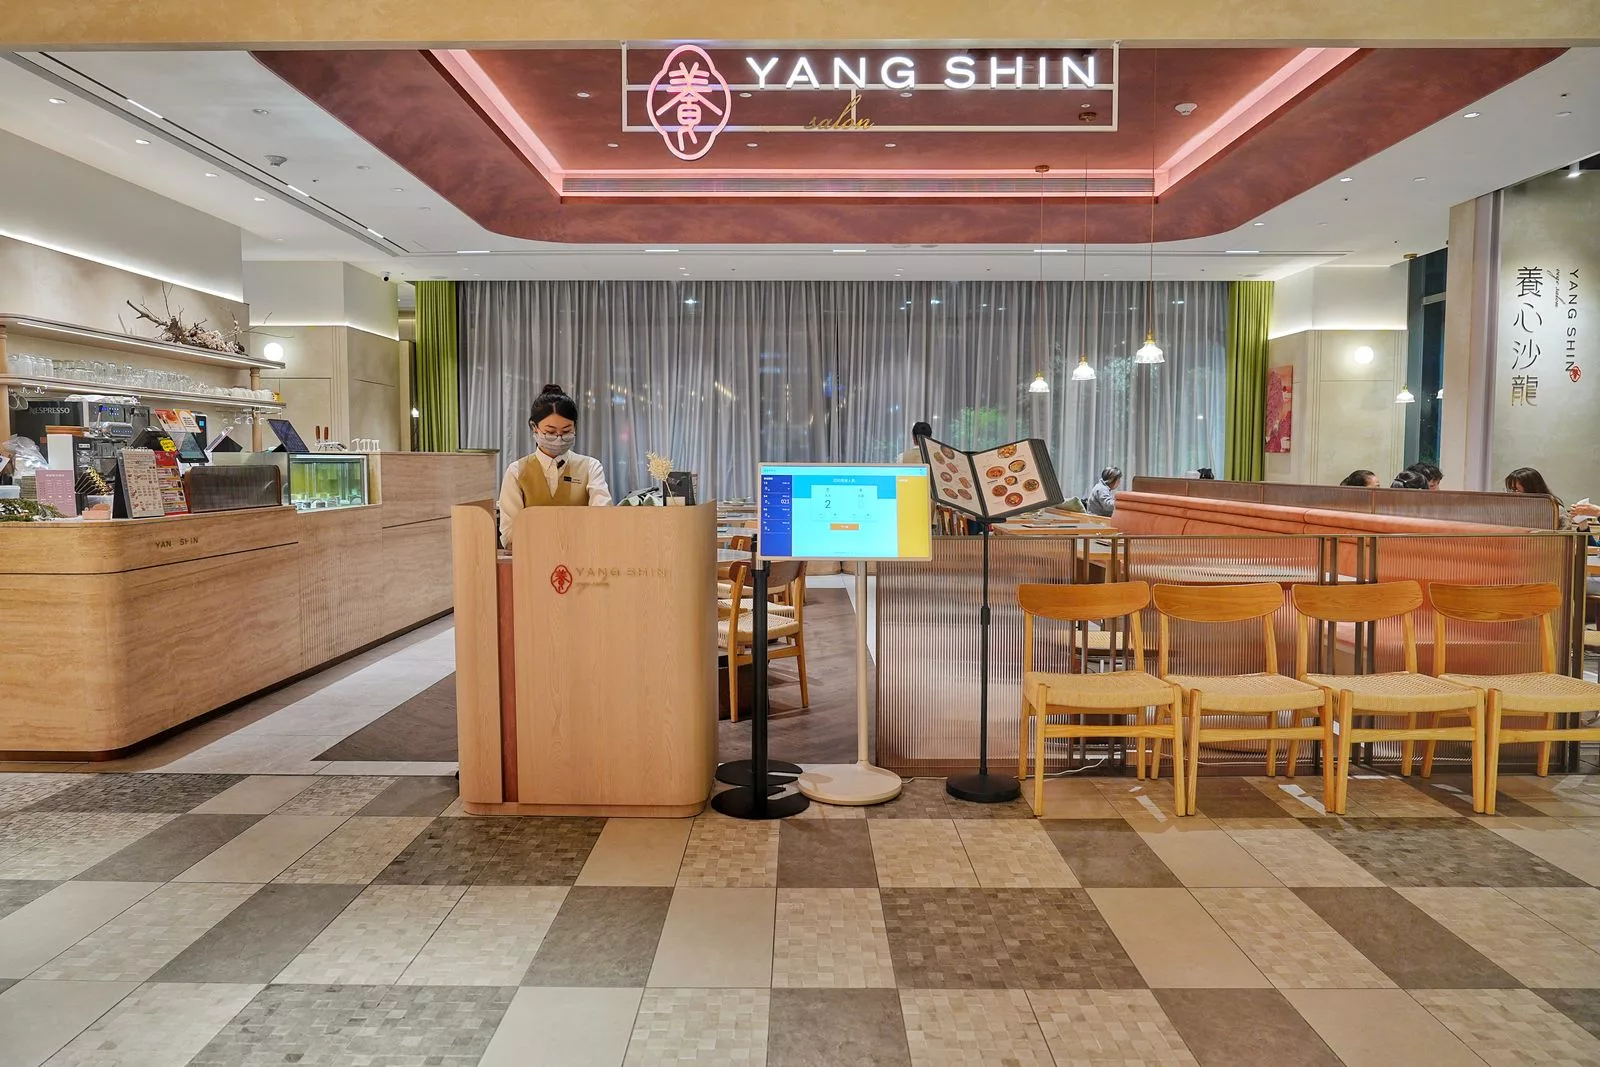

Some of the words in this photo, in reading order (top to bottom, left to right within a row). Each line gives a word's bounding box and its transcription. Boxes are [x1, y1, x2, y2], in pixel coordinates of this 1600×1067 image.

[746, 56, 916, 89] YANG
[943, 56, 1096, 89] SHIN
[803, 93, 875, 130] salon
[1567, 268, 1580, 319] YANG
[1511, 266, 1544, 407] 養心沙龍
[1565, 327, 1577, 372] SHIN
[824, 499, 831, 509] 2
[576, 567, 620, 577] YANG
